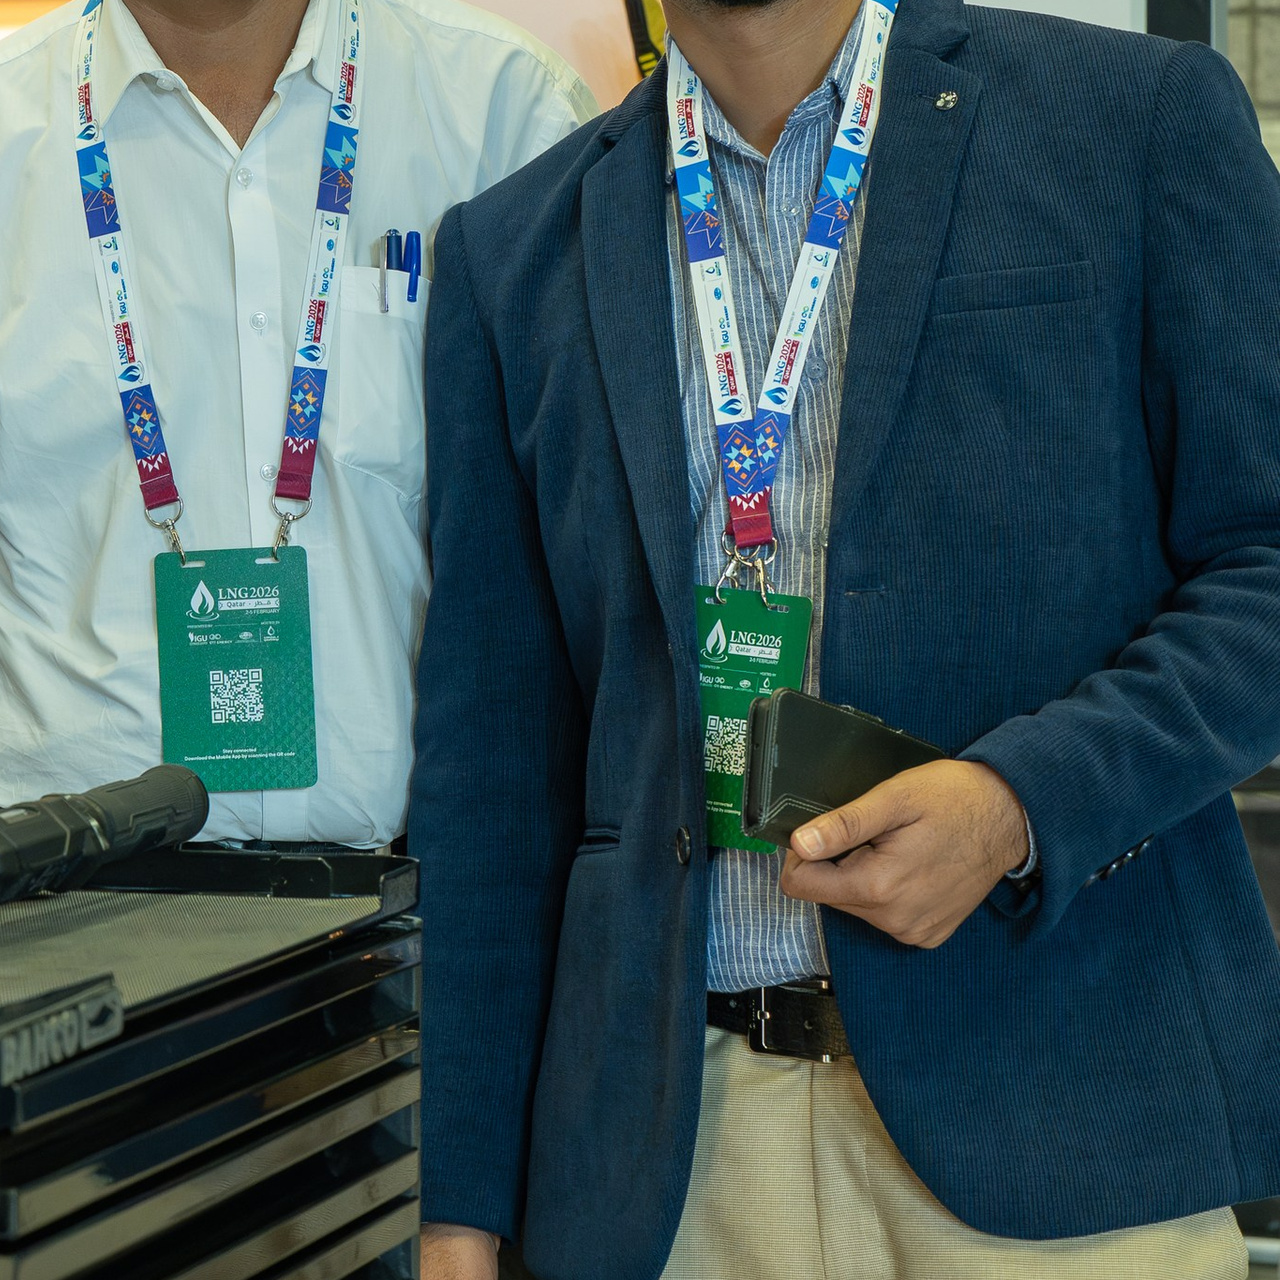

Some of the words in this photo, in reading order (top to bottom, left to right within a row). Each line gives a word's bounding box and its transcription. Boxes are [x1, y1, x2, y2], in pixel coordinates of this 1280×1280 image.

[850, 82, 867, 125] LNG2026
[676, 98, 688, 140] LNG2026
[119, 302, 128, 315] IGU
[305, 299, 317, 342] LNG2026
[721, 330, 730, 343] IGU
[798, 319, 807, 333] IGU
[113, 323, 128, 365] LNG2026
[715, 352, 730, 397] LNG2026
[773, 338, 792, 384] LNG2026
[783, 364, 792, 380] Qatar
[218, 585, 279, 600] LNG2026
[730, 630, 782, 647] LNG2026
